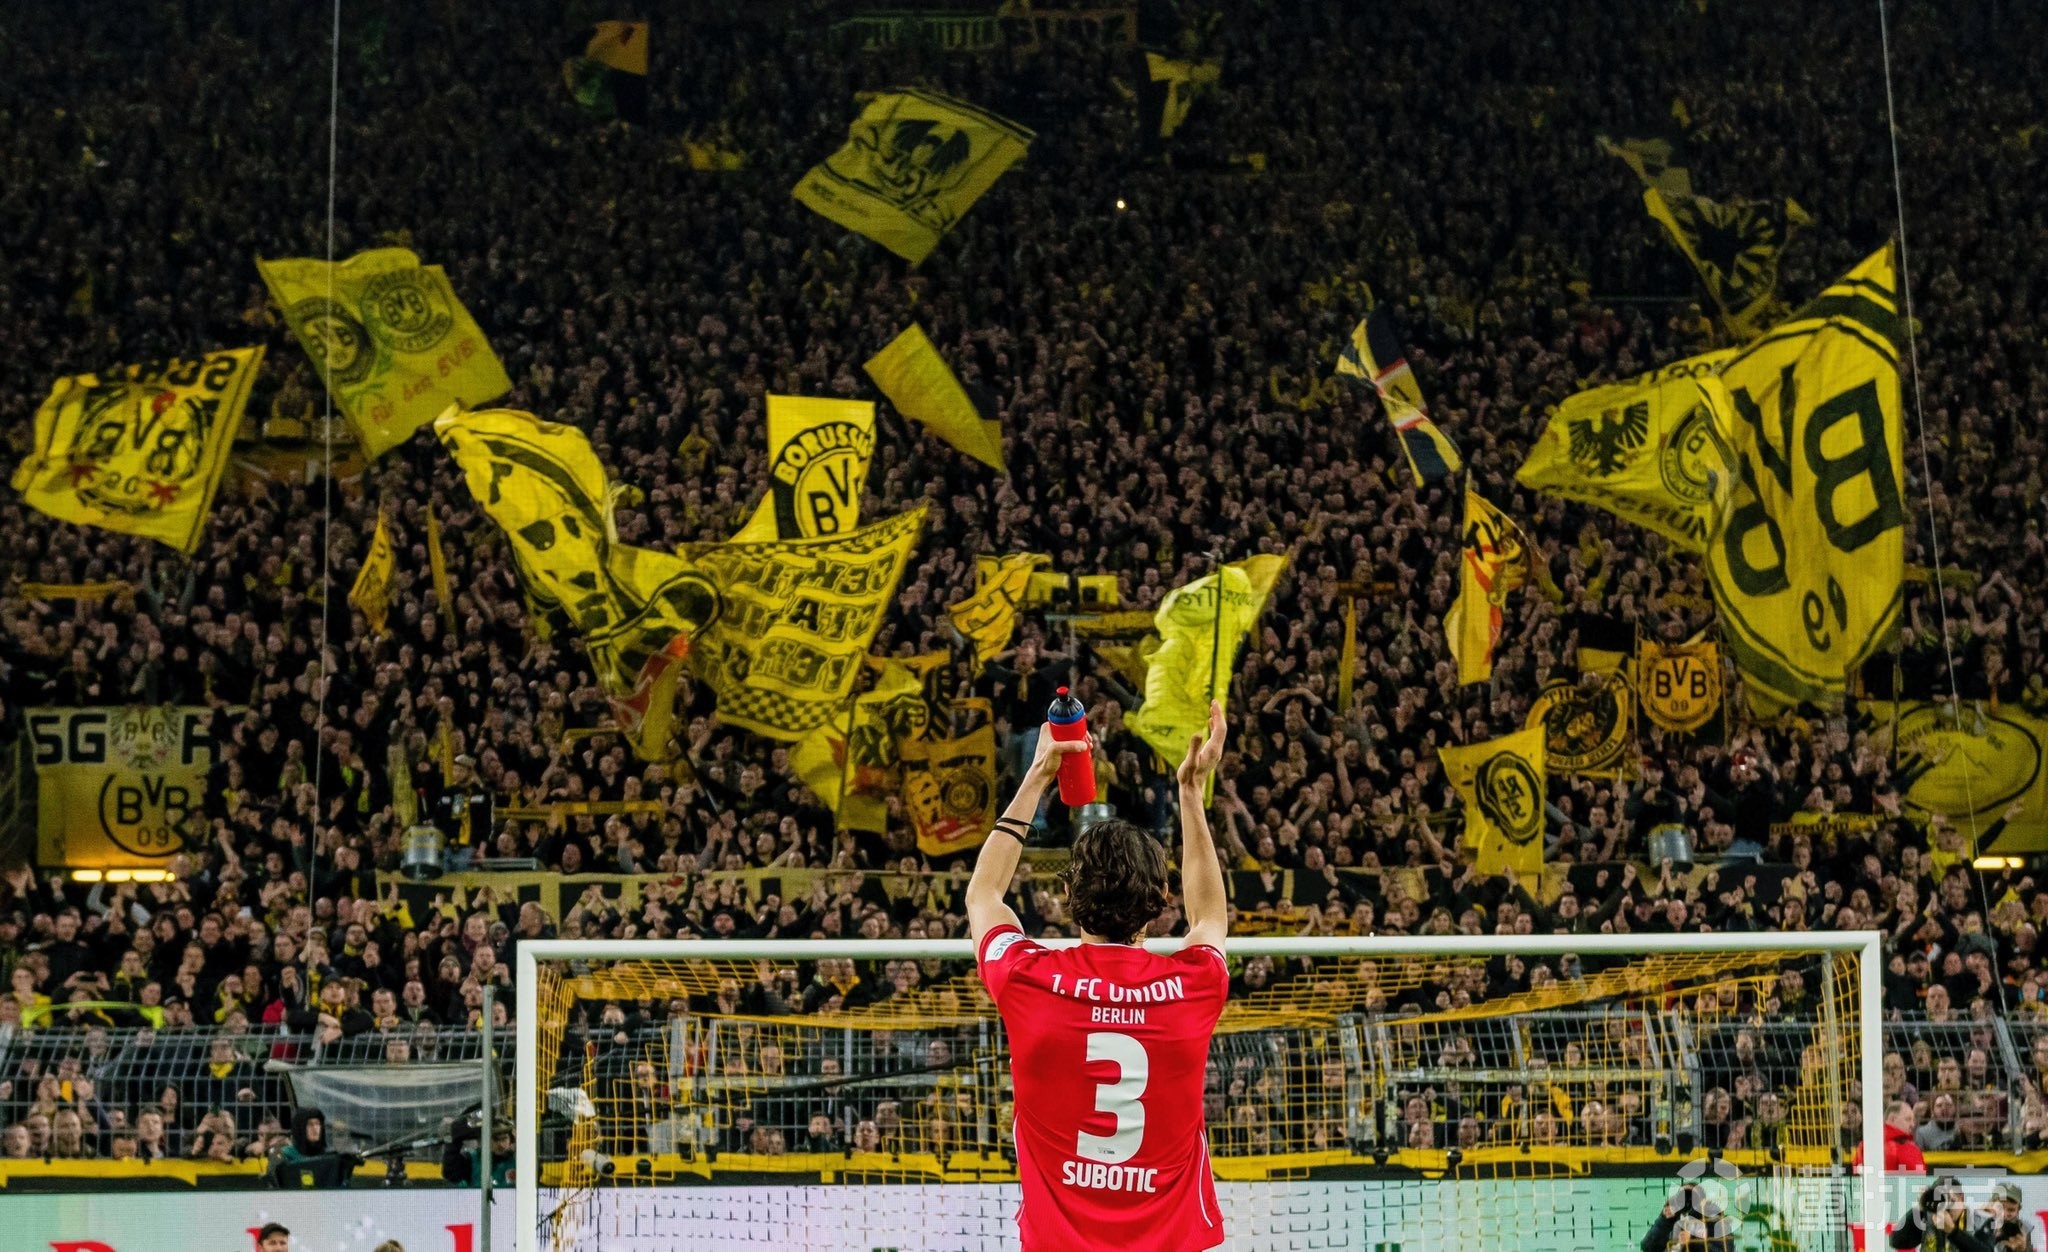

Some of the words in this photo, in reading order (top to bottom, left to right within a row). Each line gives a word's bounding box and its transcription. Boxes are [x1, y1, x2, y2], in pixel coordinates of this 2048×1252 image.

[809, 458, 858, 535] BV
[1655, 658, 1708, 699] BVB
[30, 713, 107, 764] SG
[117, 776, 190, 827] BVB
[137, 827, 169, 847] 09
[1050, 973, 1066, 996] 1.
[1074, 977, 1103, 1001] FC
[1108, 976, 1185, 1003] UNION
[1091, 1006, 1146, 1025] BERLIN
[1076, 1032, 1149, 1165] 3
[1062, 1160, 1158, 1193] SUBOTIC
